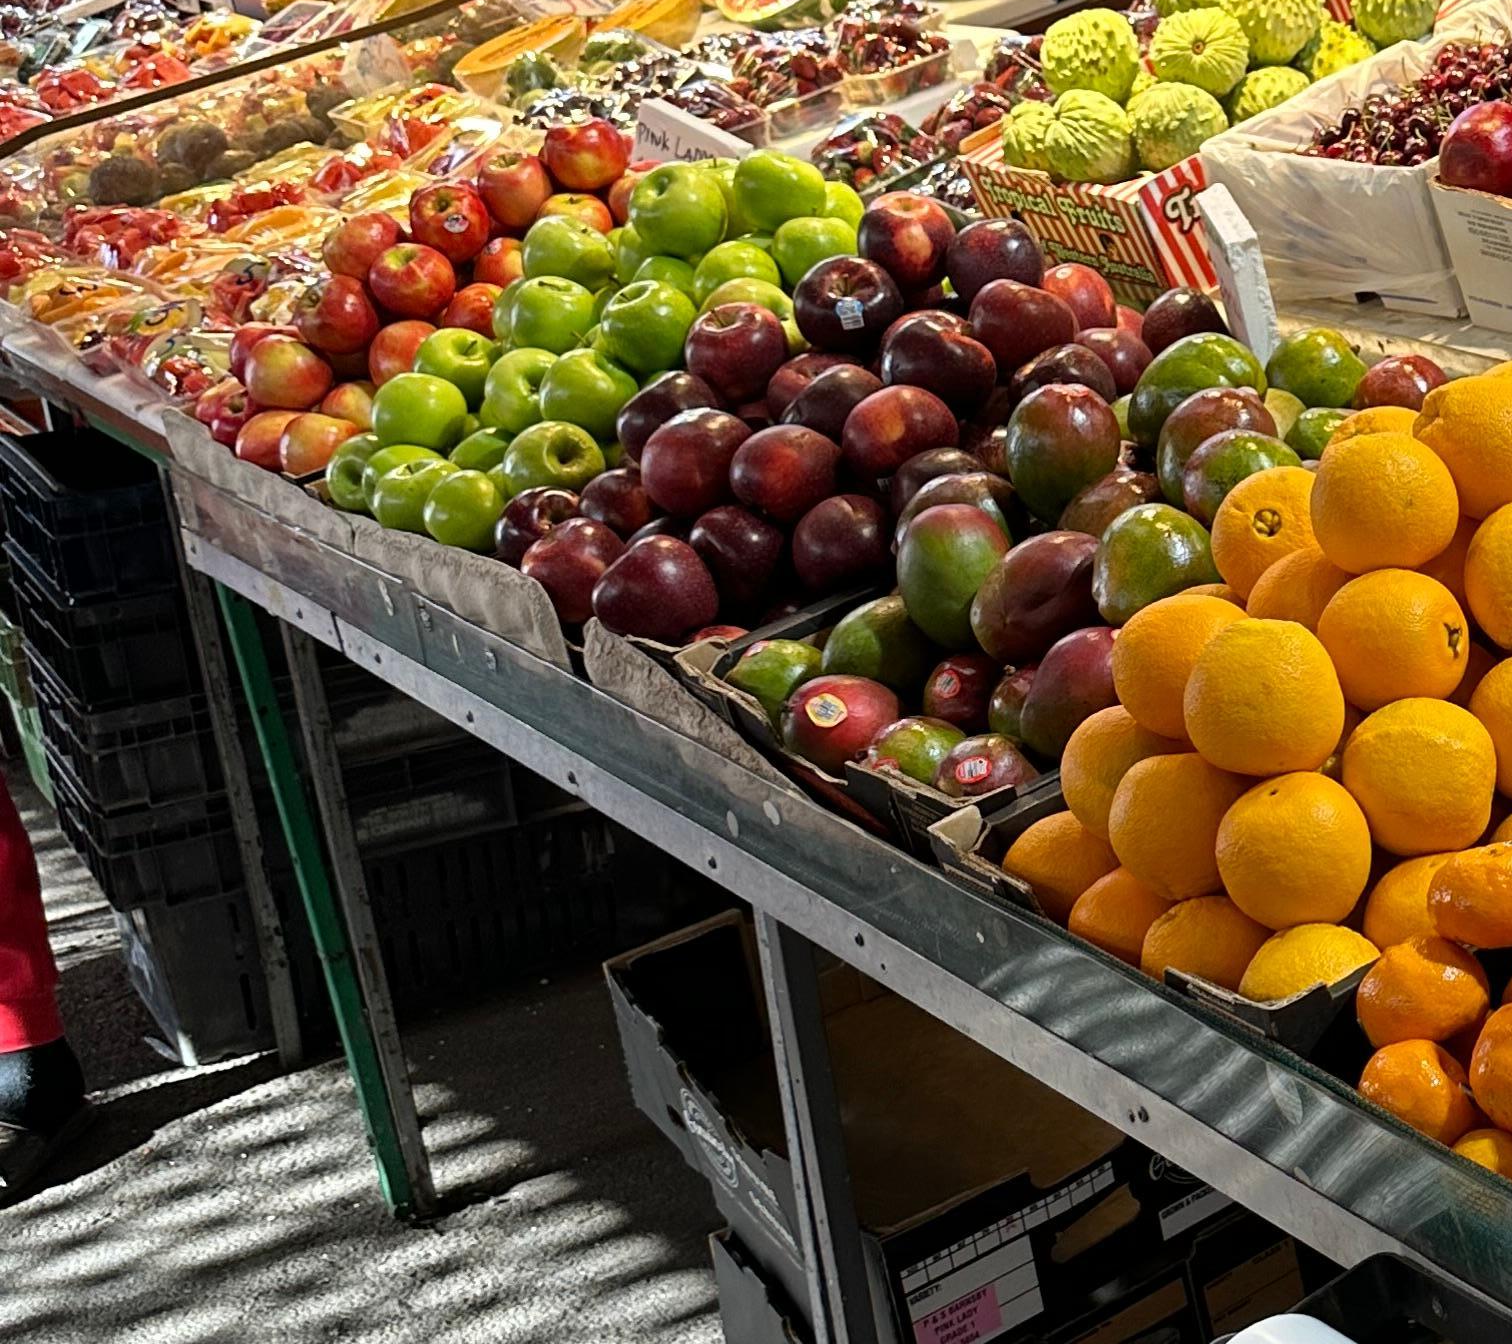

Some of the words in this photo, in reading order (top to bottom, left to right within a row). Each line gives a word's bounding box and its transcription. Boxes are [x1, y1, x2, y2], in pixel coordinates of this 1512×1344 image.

[979, 174, 1057, 217] Tropical
[1056, 196, 1127, 234] Fruits
[934, 1320, 956, 1336] PINK
[956, 1306, 979, 1325] LADY
[939, 1324, 968, 1344] GRADE
